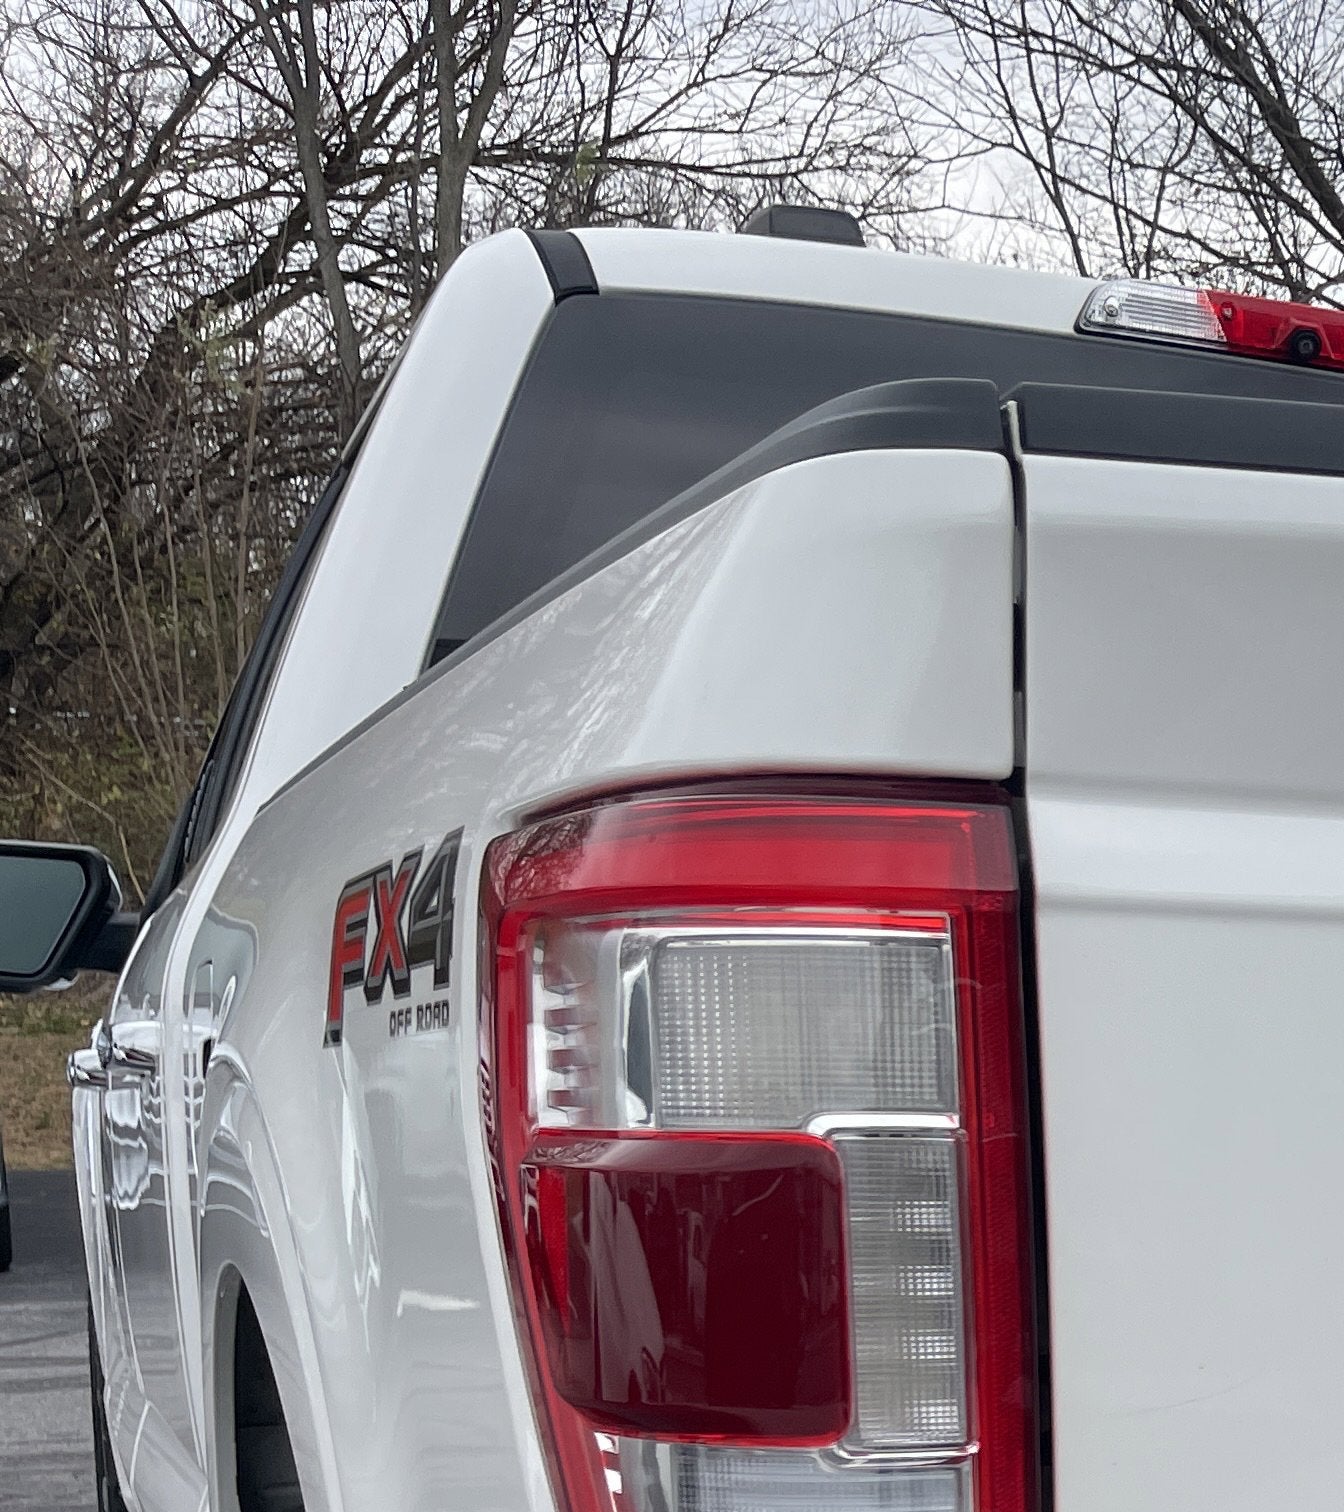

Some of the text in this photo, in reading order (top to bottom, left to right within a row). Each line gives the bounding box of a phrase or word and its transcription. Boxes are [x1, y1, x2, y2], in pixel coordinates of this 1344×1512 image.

[322, 824, 465, 1049] FX4
[389, 1000, 449, 1037] OFF ROAD
